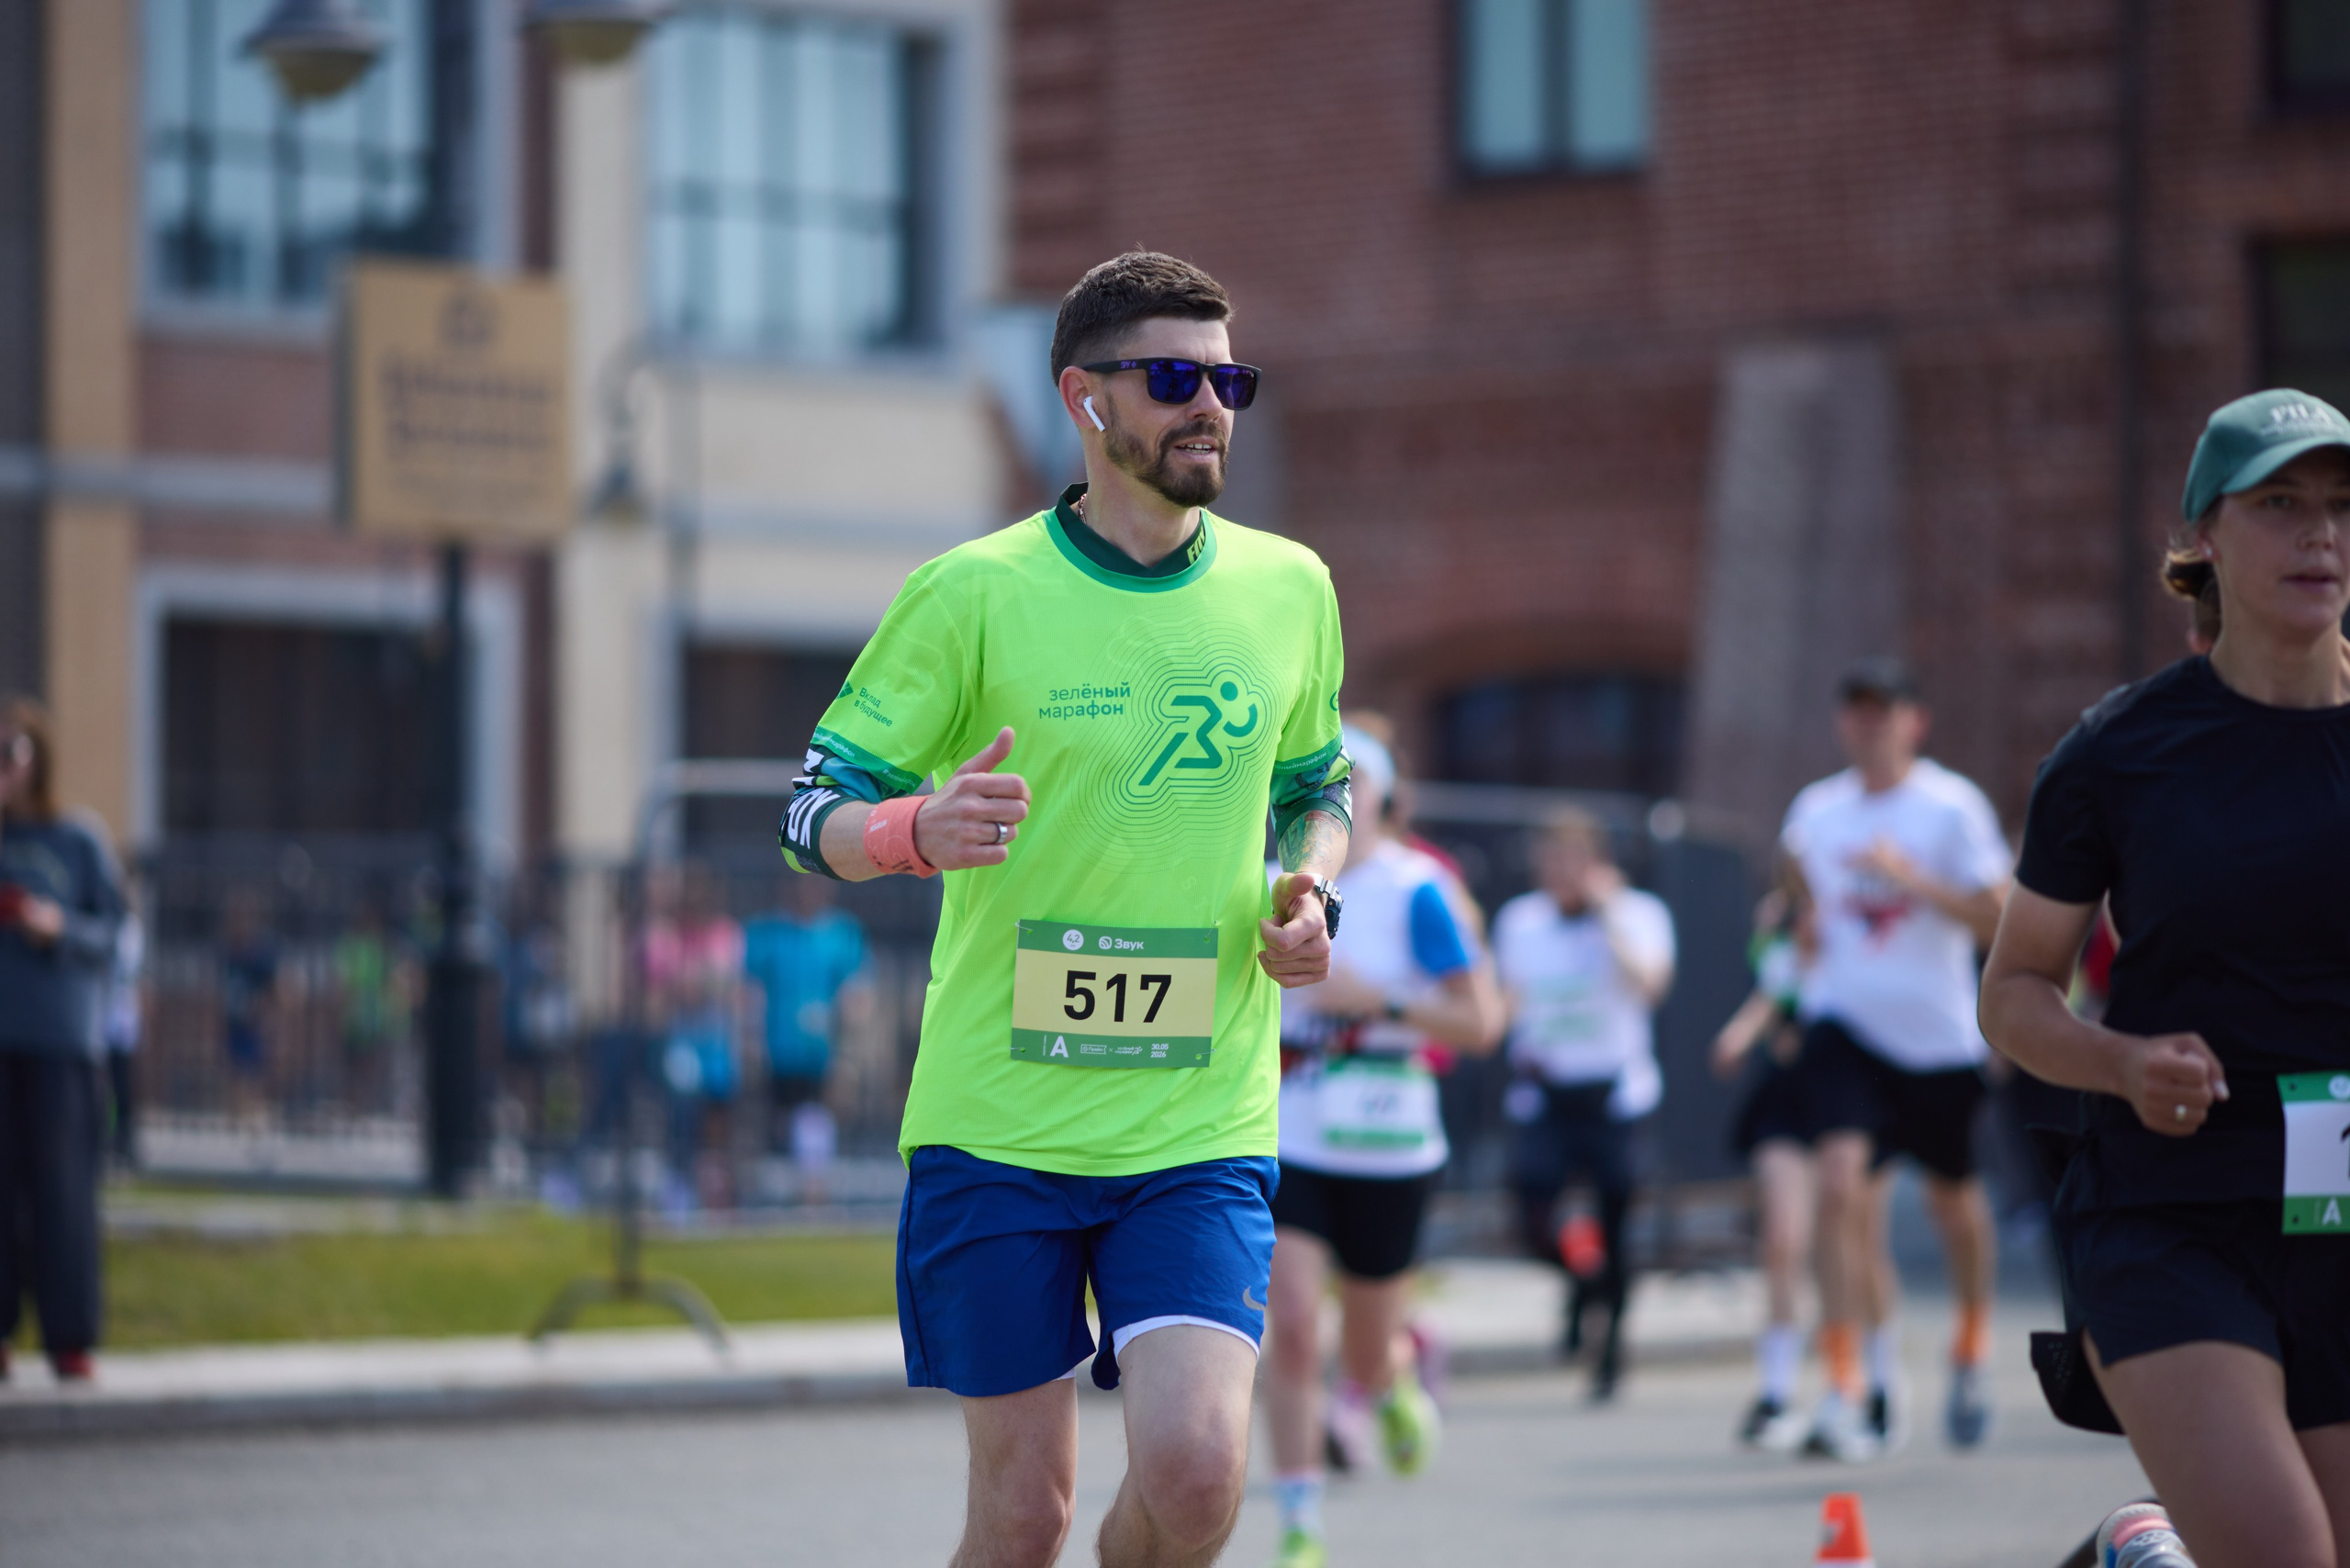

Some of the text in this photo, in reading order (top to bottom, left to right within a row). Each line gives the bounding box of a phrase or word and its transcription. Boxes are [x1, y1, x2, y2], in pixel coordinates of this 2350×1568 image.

[859, 688, 881, 708] Вклад
[1049, 682, 1130, 700] зелёный
[859, 700, 893, 727] будущее
[1039, 700, 1124, 721] марафон
[1067, 934, 1144, 951] 4,2 Звук
[1063, 969, 1172, 1023] 517
